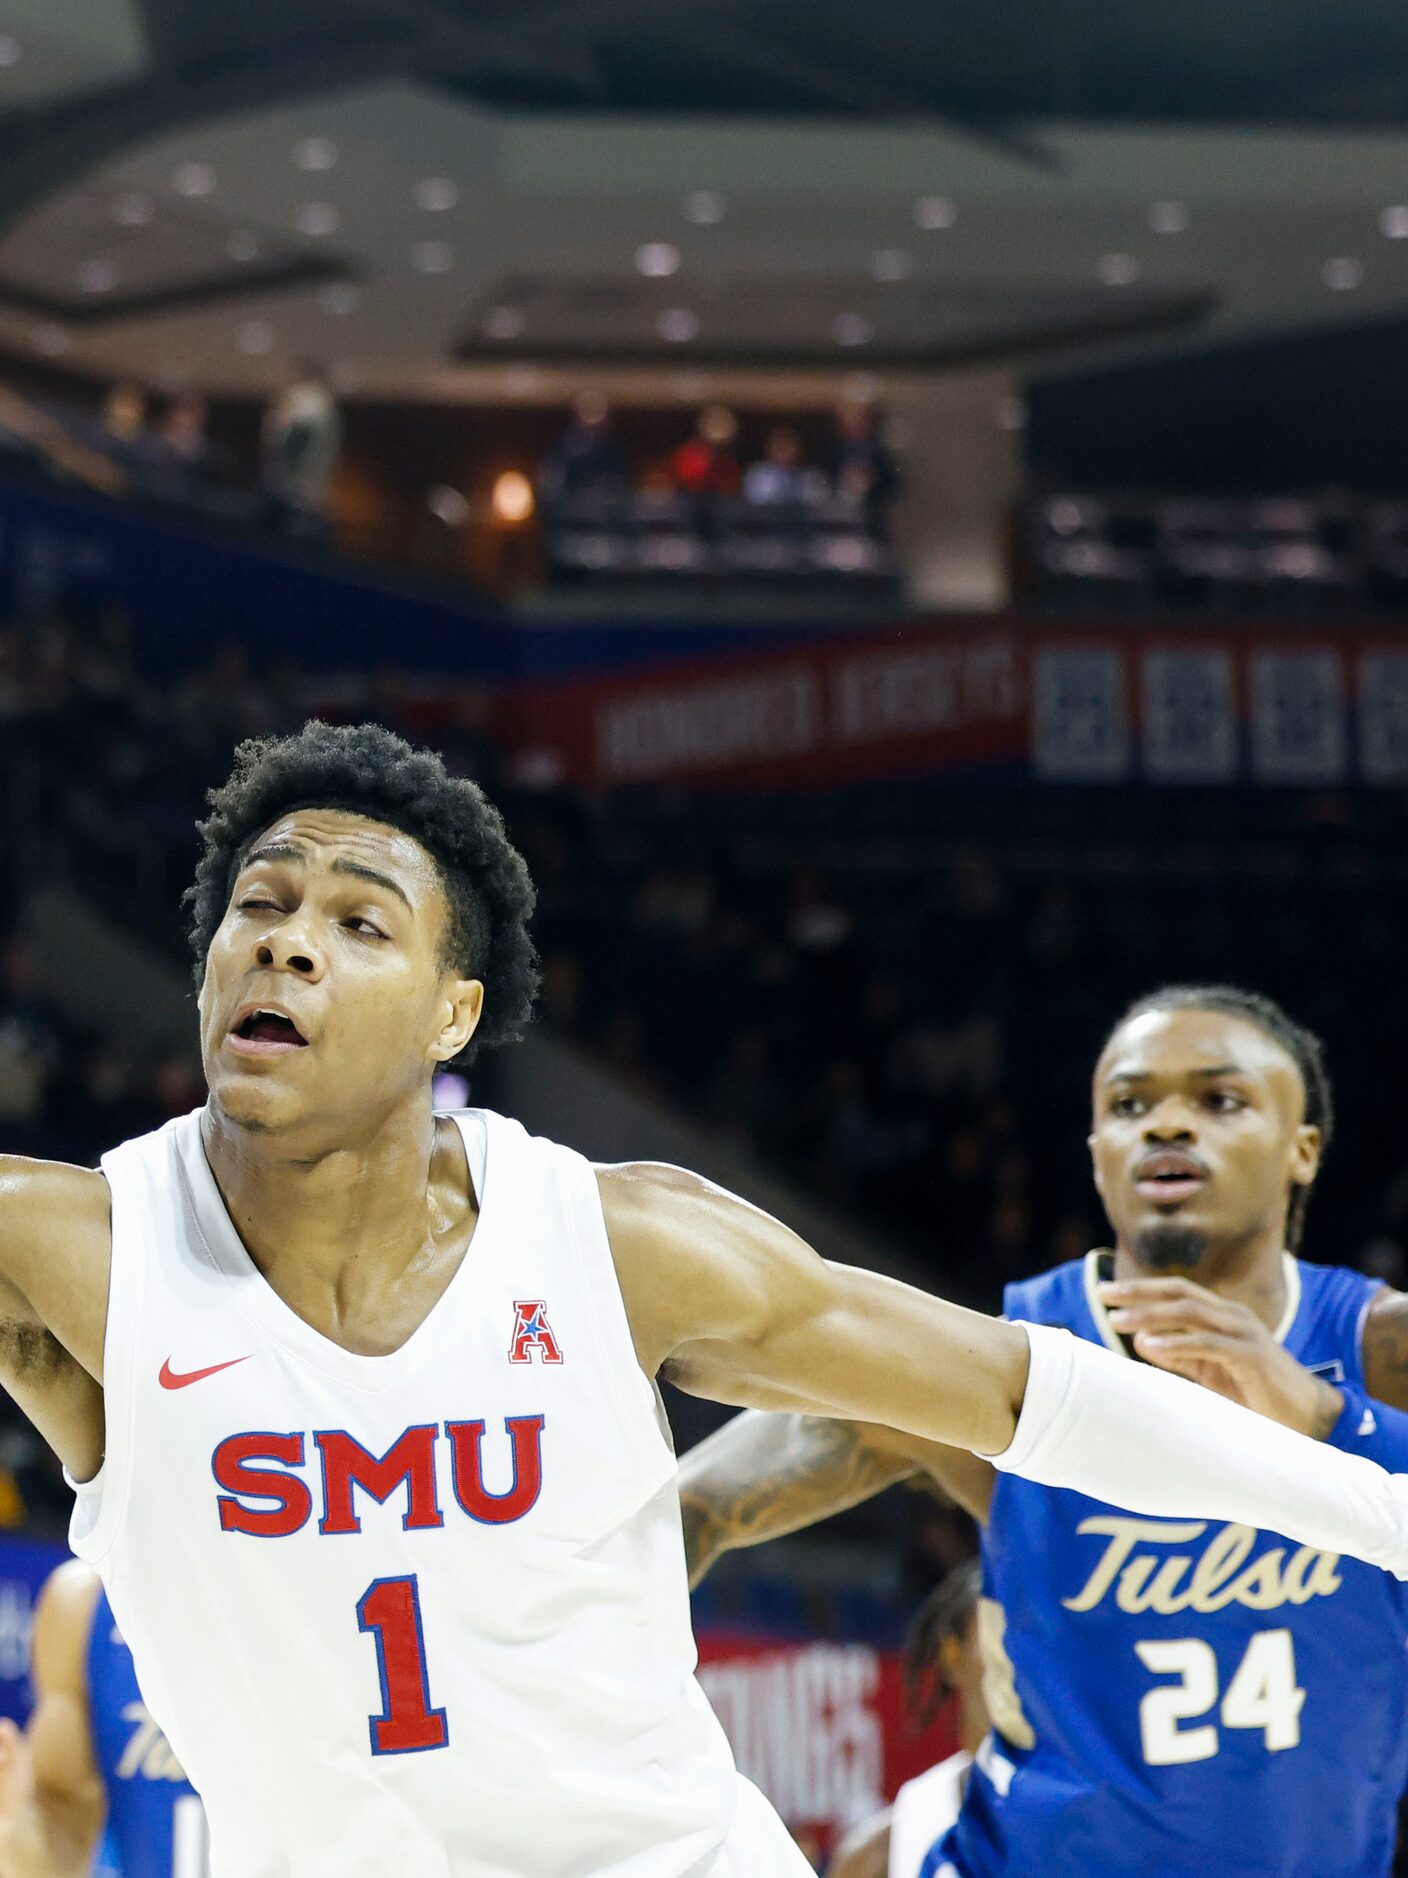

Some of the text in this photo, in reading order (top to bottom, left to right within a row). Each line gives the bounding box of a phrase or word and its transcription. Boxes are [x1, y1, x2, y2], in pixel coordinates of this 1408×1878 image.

[211, 1413, 545, 1538] SMU
[1061, 1516, 1342, 1614] Tulsa
[355, 1573, 450, 1756] 1
[1134, 1628, 1306, 1766] 24
